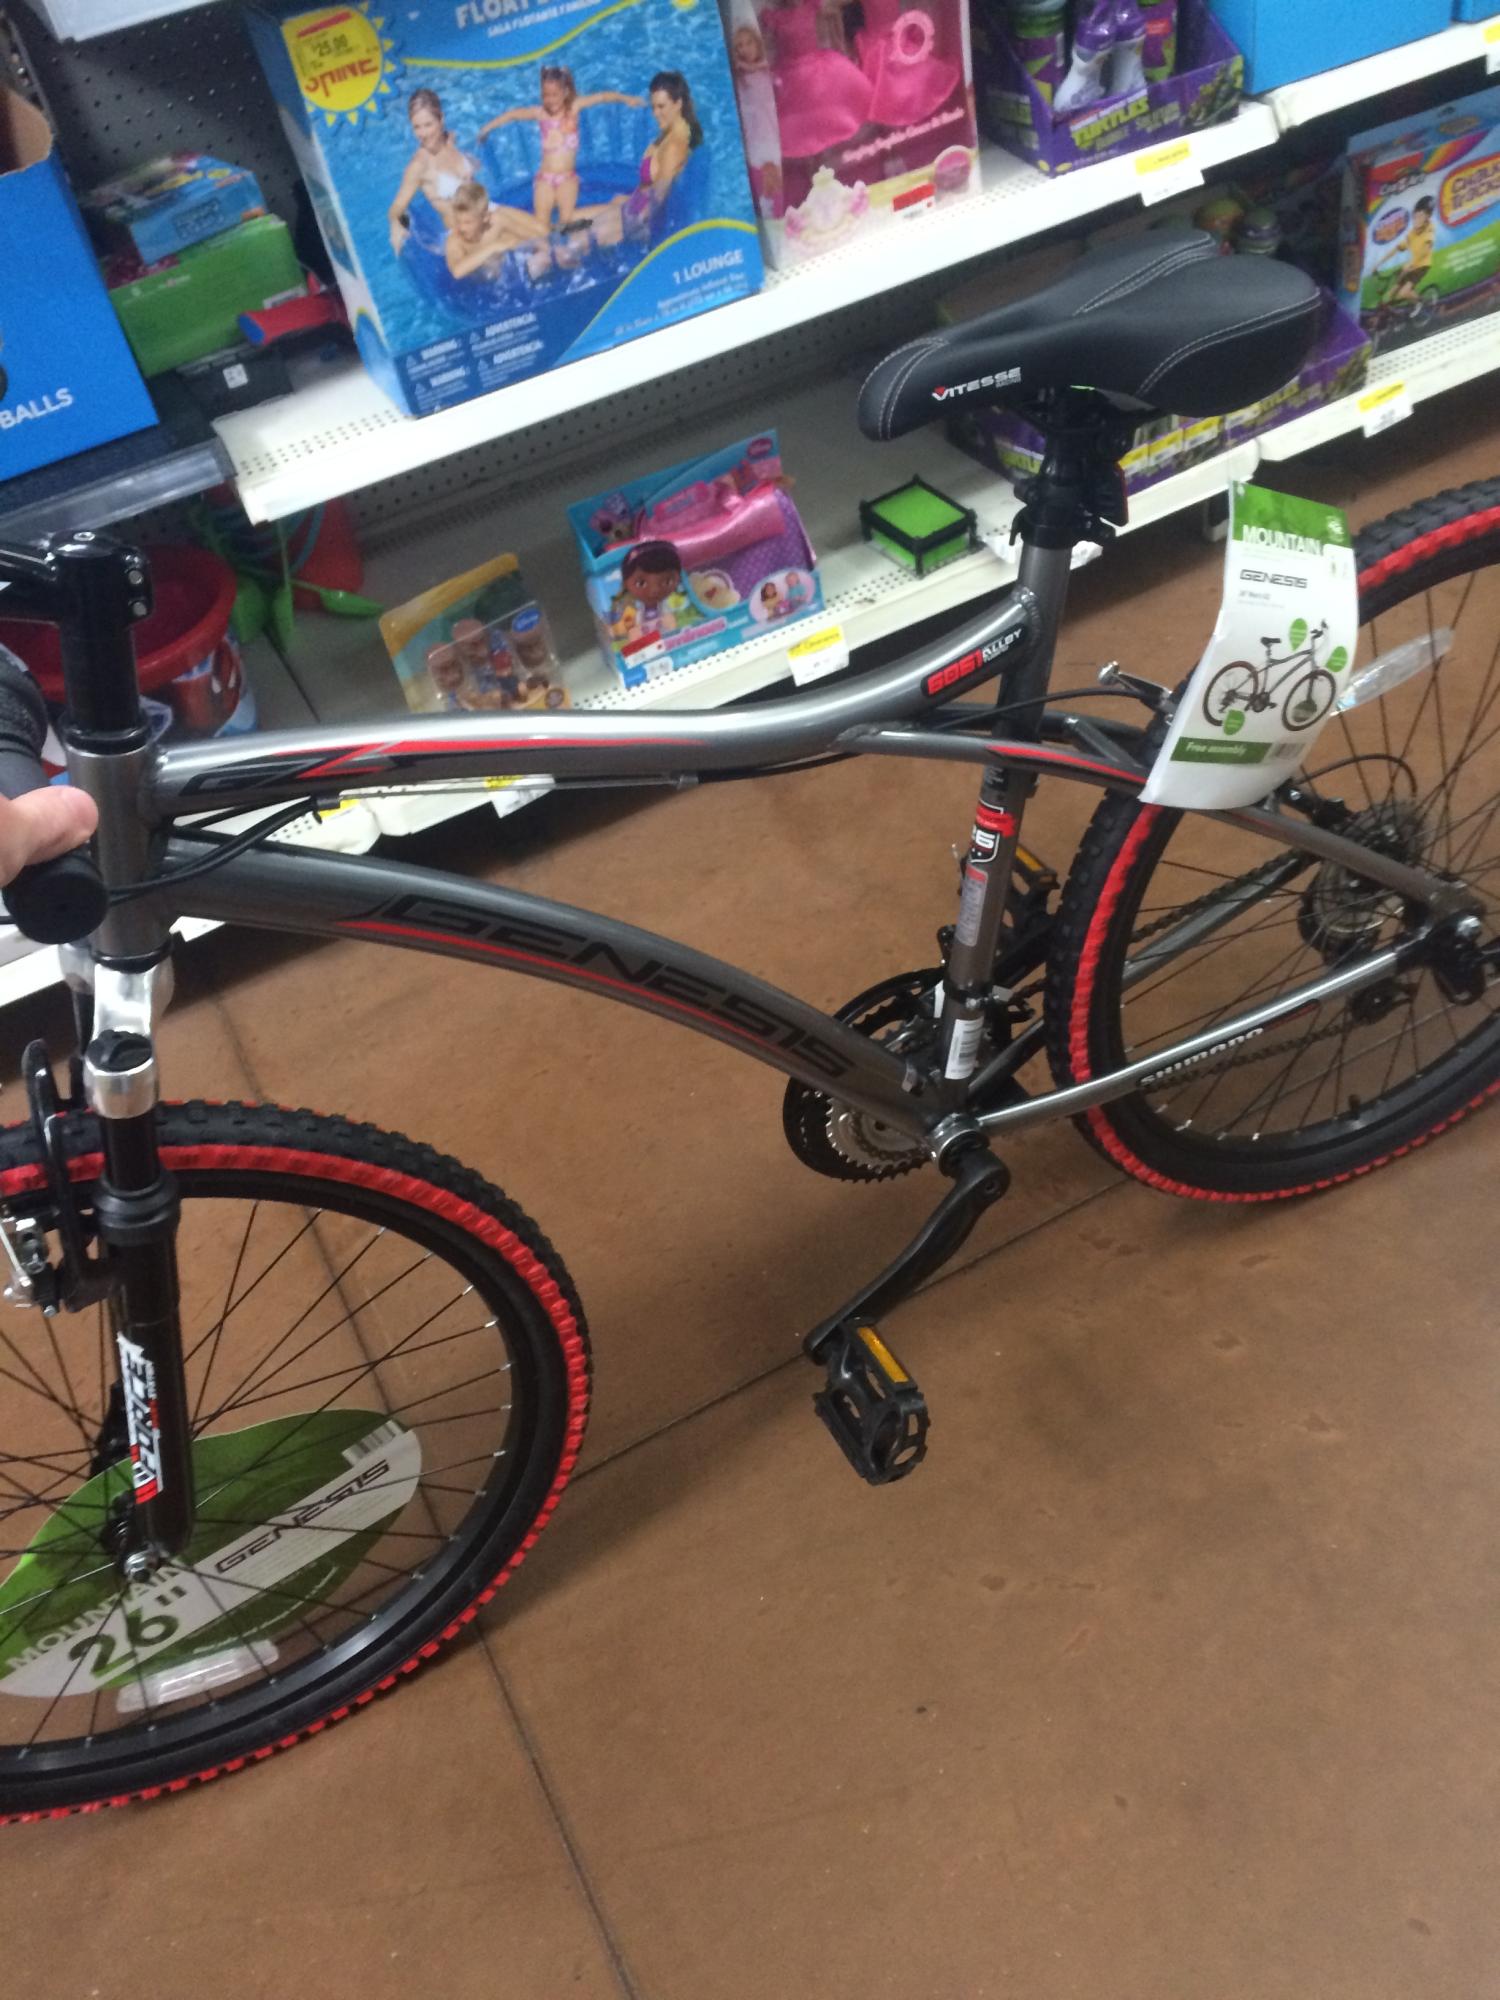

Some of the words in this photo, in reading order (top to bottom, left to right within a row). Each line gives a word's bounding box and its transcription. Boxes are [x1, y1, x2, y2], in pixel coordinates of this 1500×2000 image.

[684, 249, 745, 282] LOUNGE
[931, 366, 1021, 401] VITESSE
[0, 387, 74, 430] BALLS
[1242, 523, 1323, 557] MOUNTAIN
[1239, 568, 1309, 589] GENESIS
[926, 648, 984, 697] 6061
[982, 628, 1022, 656] ALLOY
[392, 893, 857, 1079] GENESIS
[214, 1458, 391, 1574] GENESIS
[5, 1558, 185, 1671] MOUNTAIN
